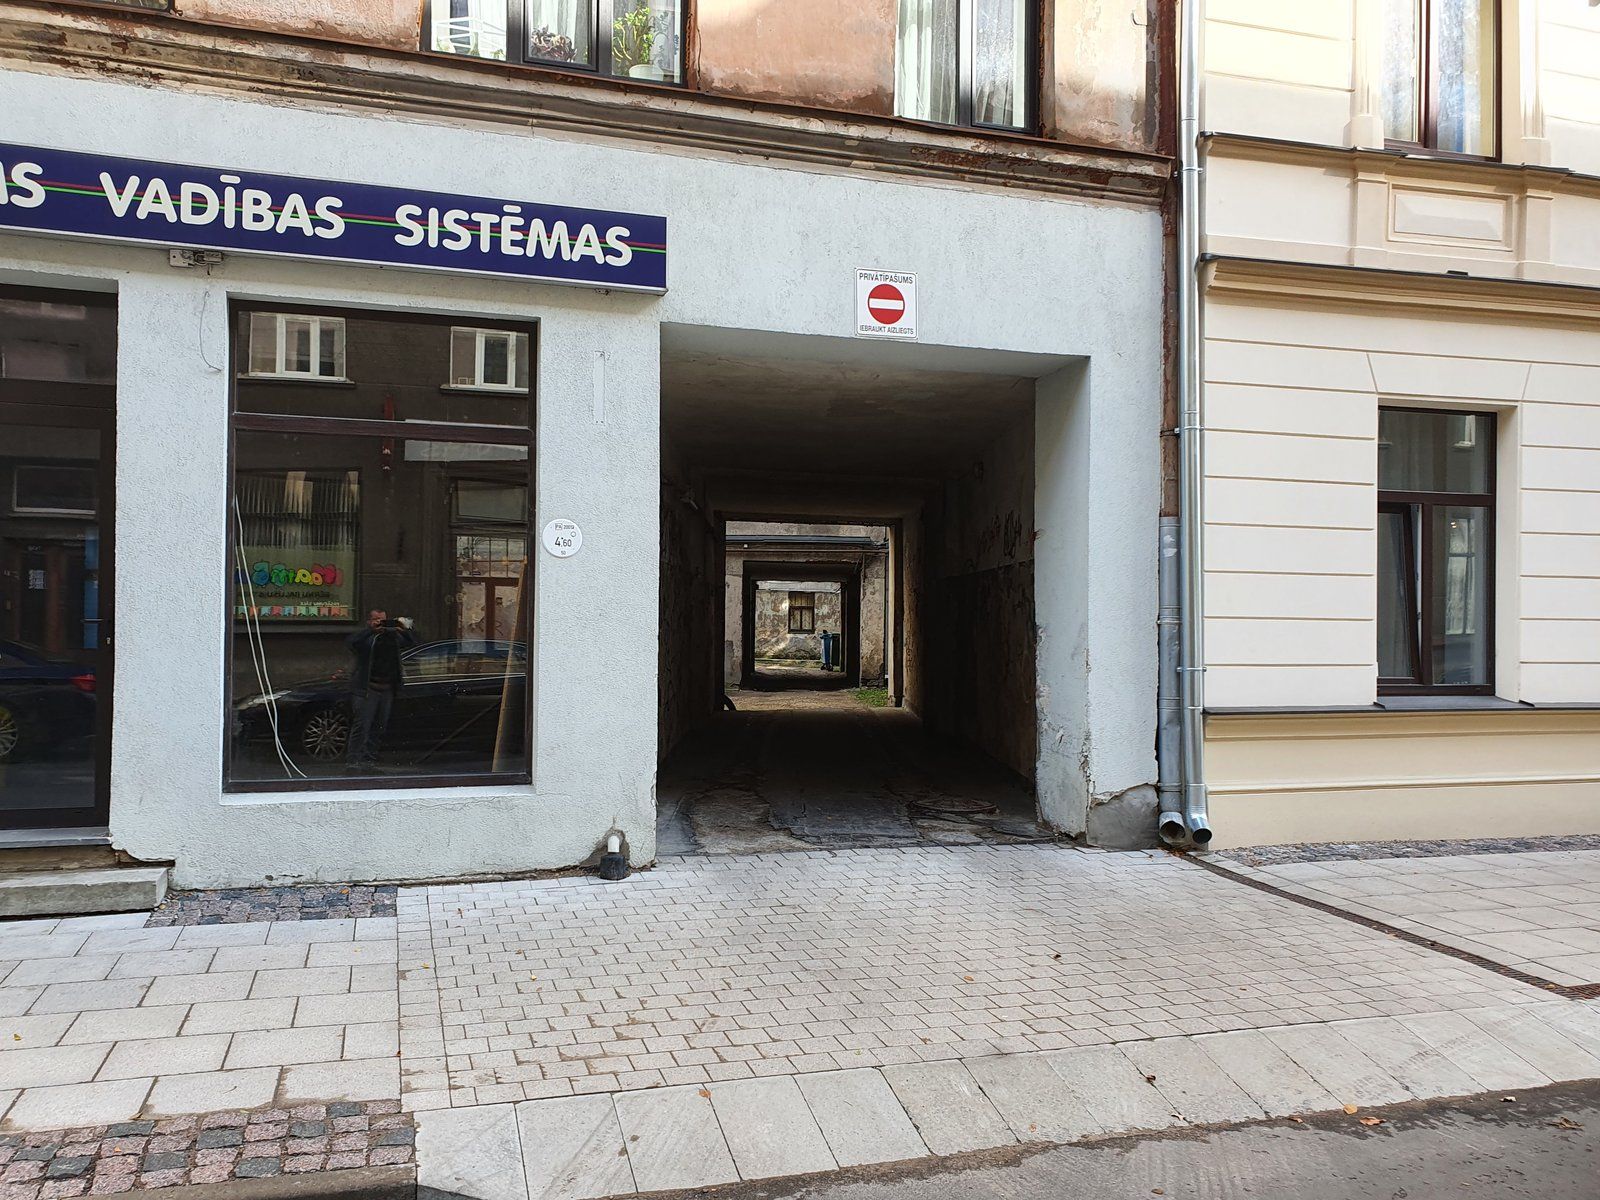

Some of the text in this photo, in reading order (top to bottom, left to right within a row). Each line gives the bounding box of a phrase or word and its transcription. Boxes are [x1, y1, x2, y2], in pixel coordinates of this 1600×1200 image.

[0, 160, 633, 267] S VADĪBAS SISTĒMAS
[860, 325, 914, 335] IEBRAUKT AIZLIEGTS
